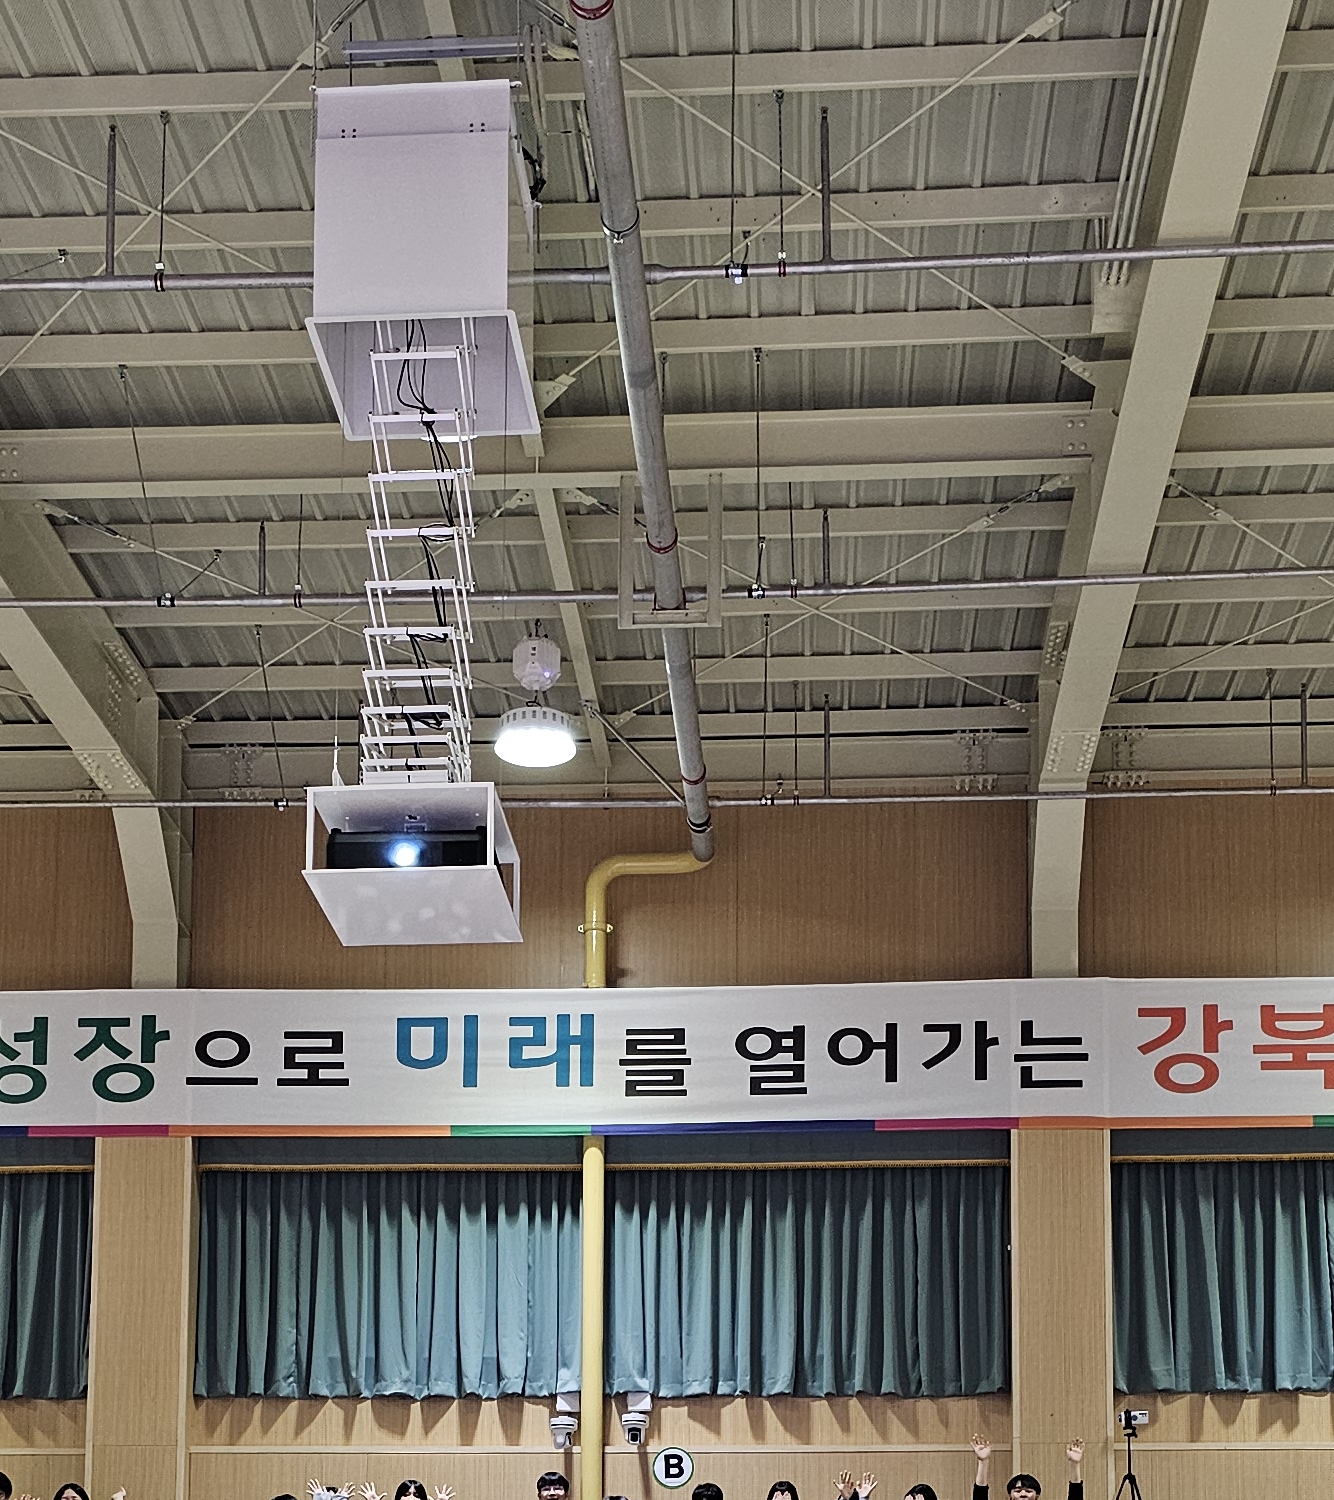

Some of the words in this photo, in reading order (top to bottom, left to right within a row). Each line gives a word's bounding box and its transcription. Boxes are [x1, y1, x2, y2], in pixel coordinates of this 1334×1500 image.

[397, 1014, 691, 1096] 미래를
[735, 1020, 1089, 1092] 열어가는
[664, 1454, 684, 1478] B
